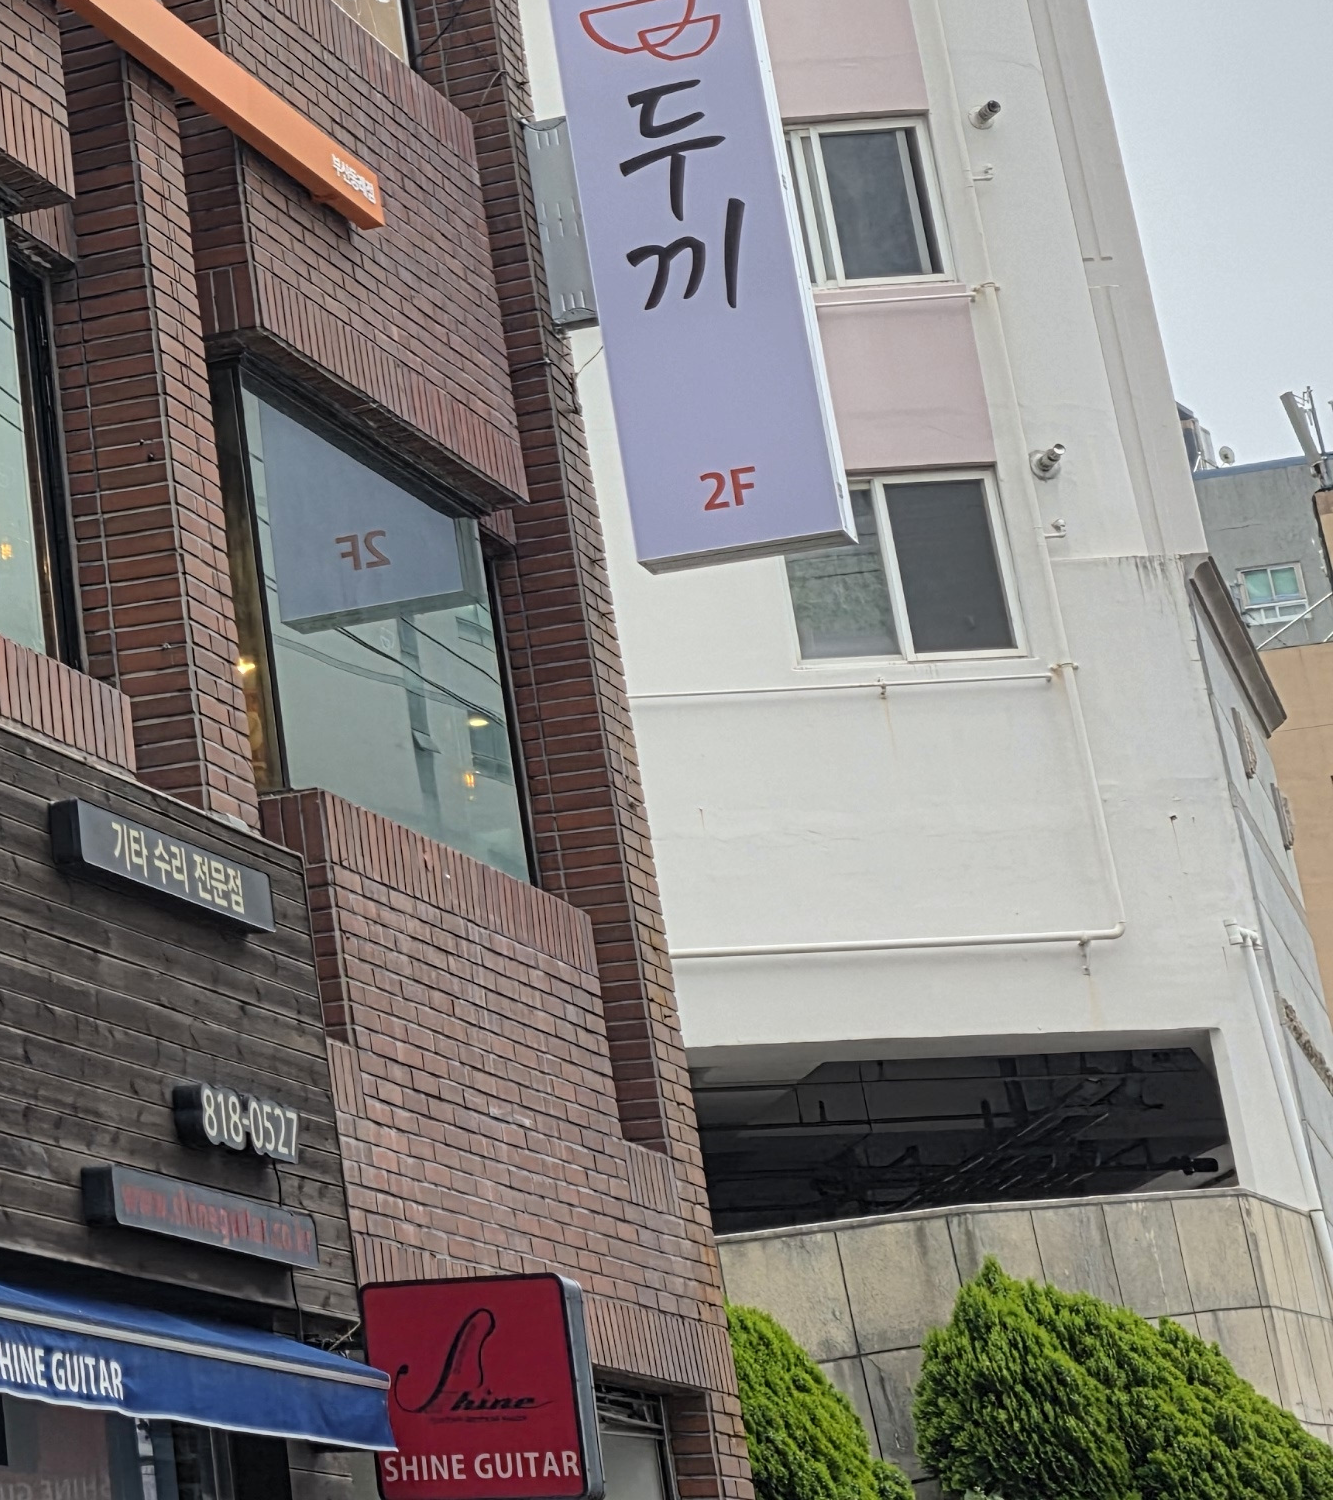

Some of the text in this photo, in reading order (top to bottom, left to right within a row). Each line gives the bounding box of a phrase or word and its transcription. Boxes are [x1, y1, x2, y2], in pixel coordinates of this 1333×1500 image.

[618, 78, 745, 311] 두끼
[699, 465, 757, 512] 2F
[111, 821, 245, 915] 기타 수리 전문점
[202, 1088, 298, 1157] 818-0527
[51, 1351, 124, 1401] GUITAR
[384, 1449, 581, 1482] SHINE GUITAR
